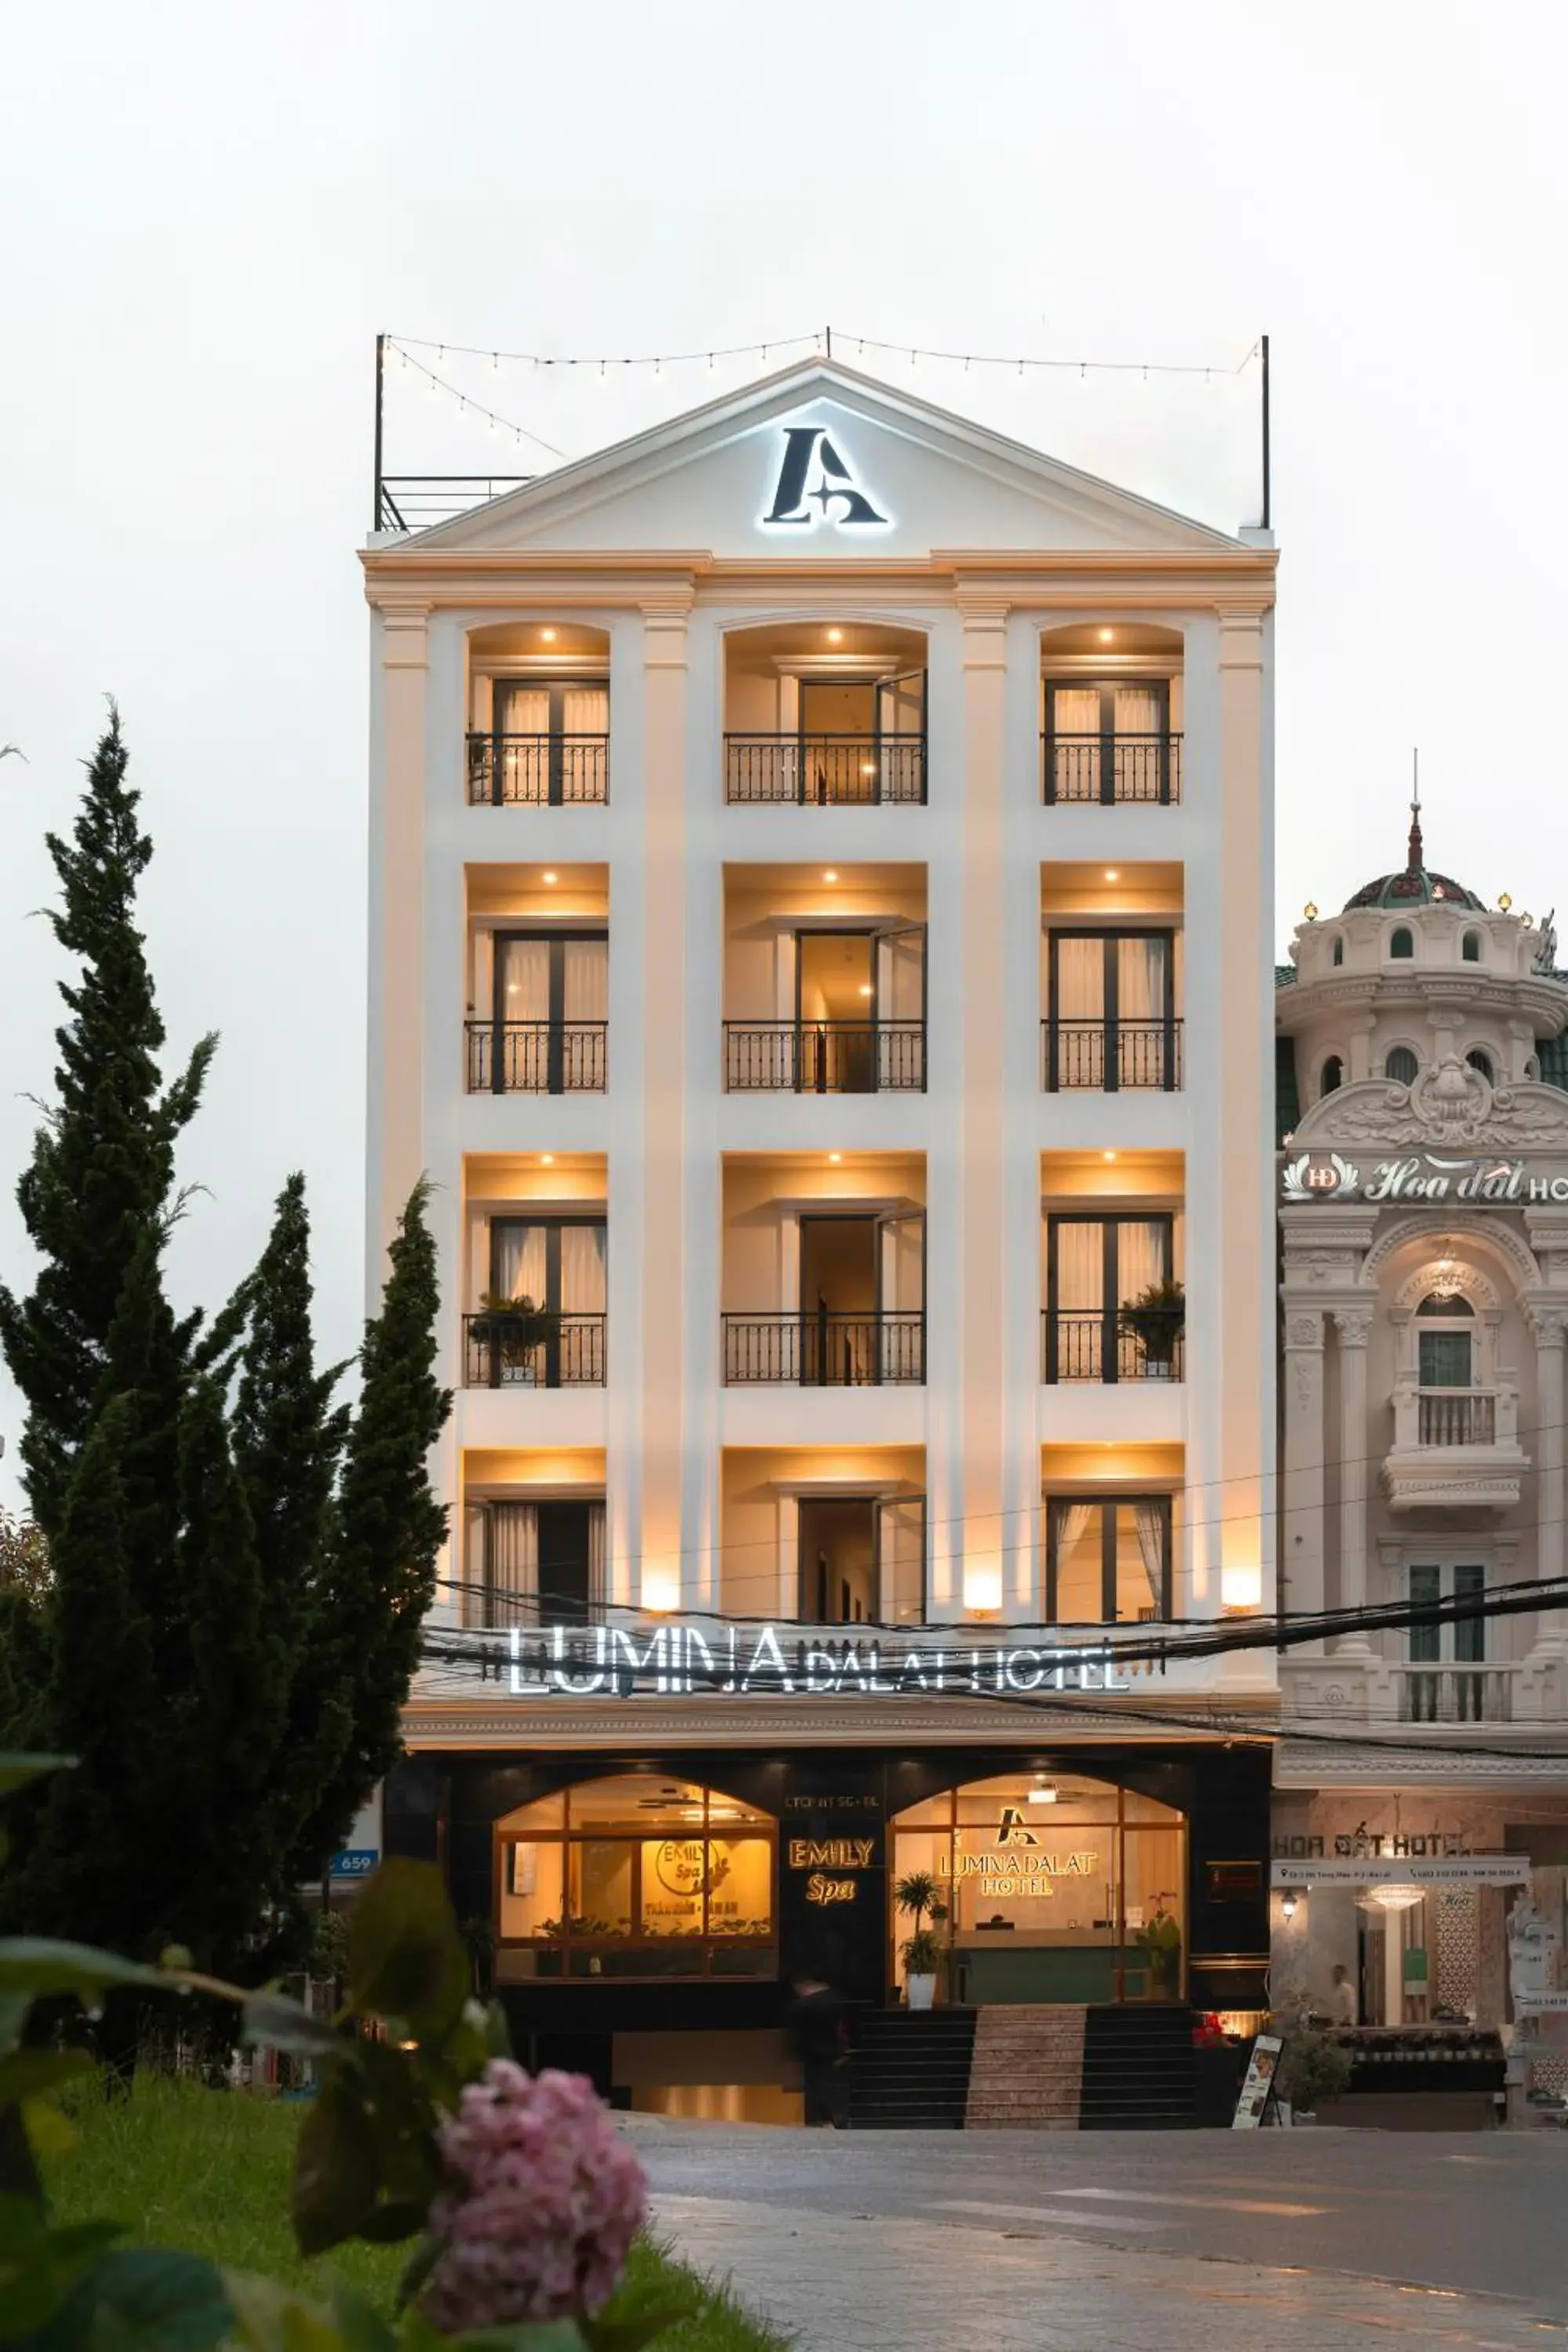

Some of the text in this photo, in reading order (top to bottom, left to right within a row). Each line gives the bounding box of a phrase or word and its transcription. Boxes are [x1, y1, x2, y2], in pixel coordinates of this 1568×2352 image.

[510, 1626, 794, 1693] LUMINA
[971, 1649, 1130, 1690] HOTEL
[789, 1839, 875, 1869] EMILY
[1272, 1835, 1325, 1859] HOA
[341, 1856, 372, 1870] 659
[676, 1863, 701, 1880] Spa
[941, 1854, 1094, 1875] LUMINA DALAT
[805, 1874, 856, 1906] Spa
[982, 1878, 1052, 1895] HOTEL
